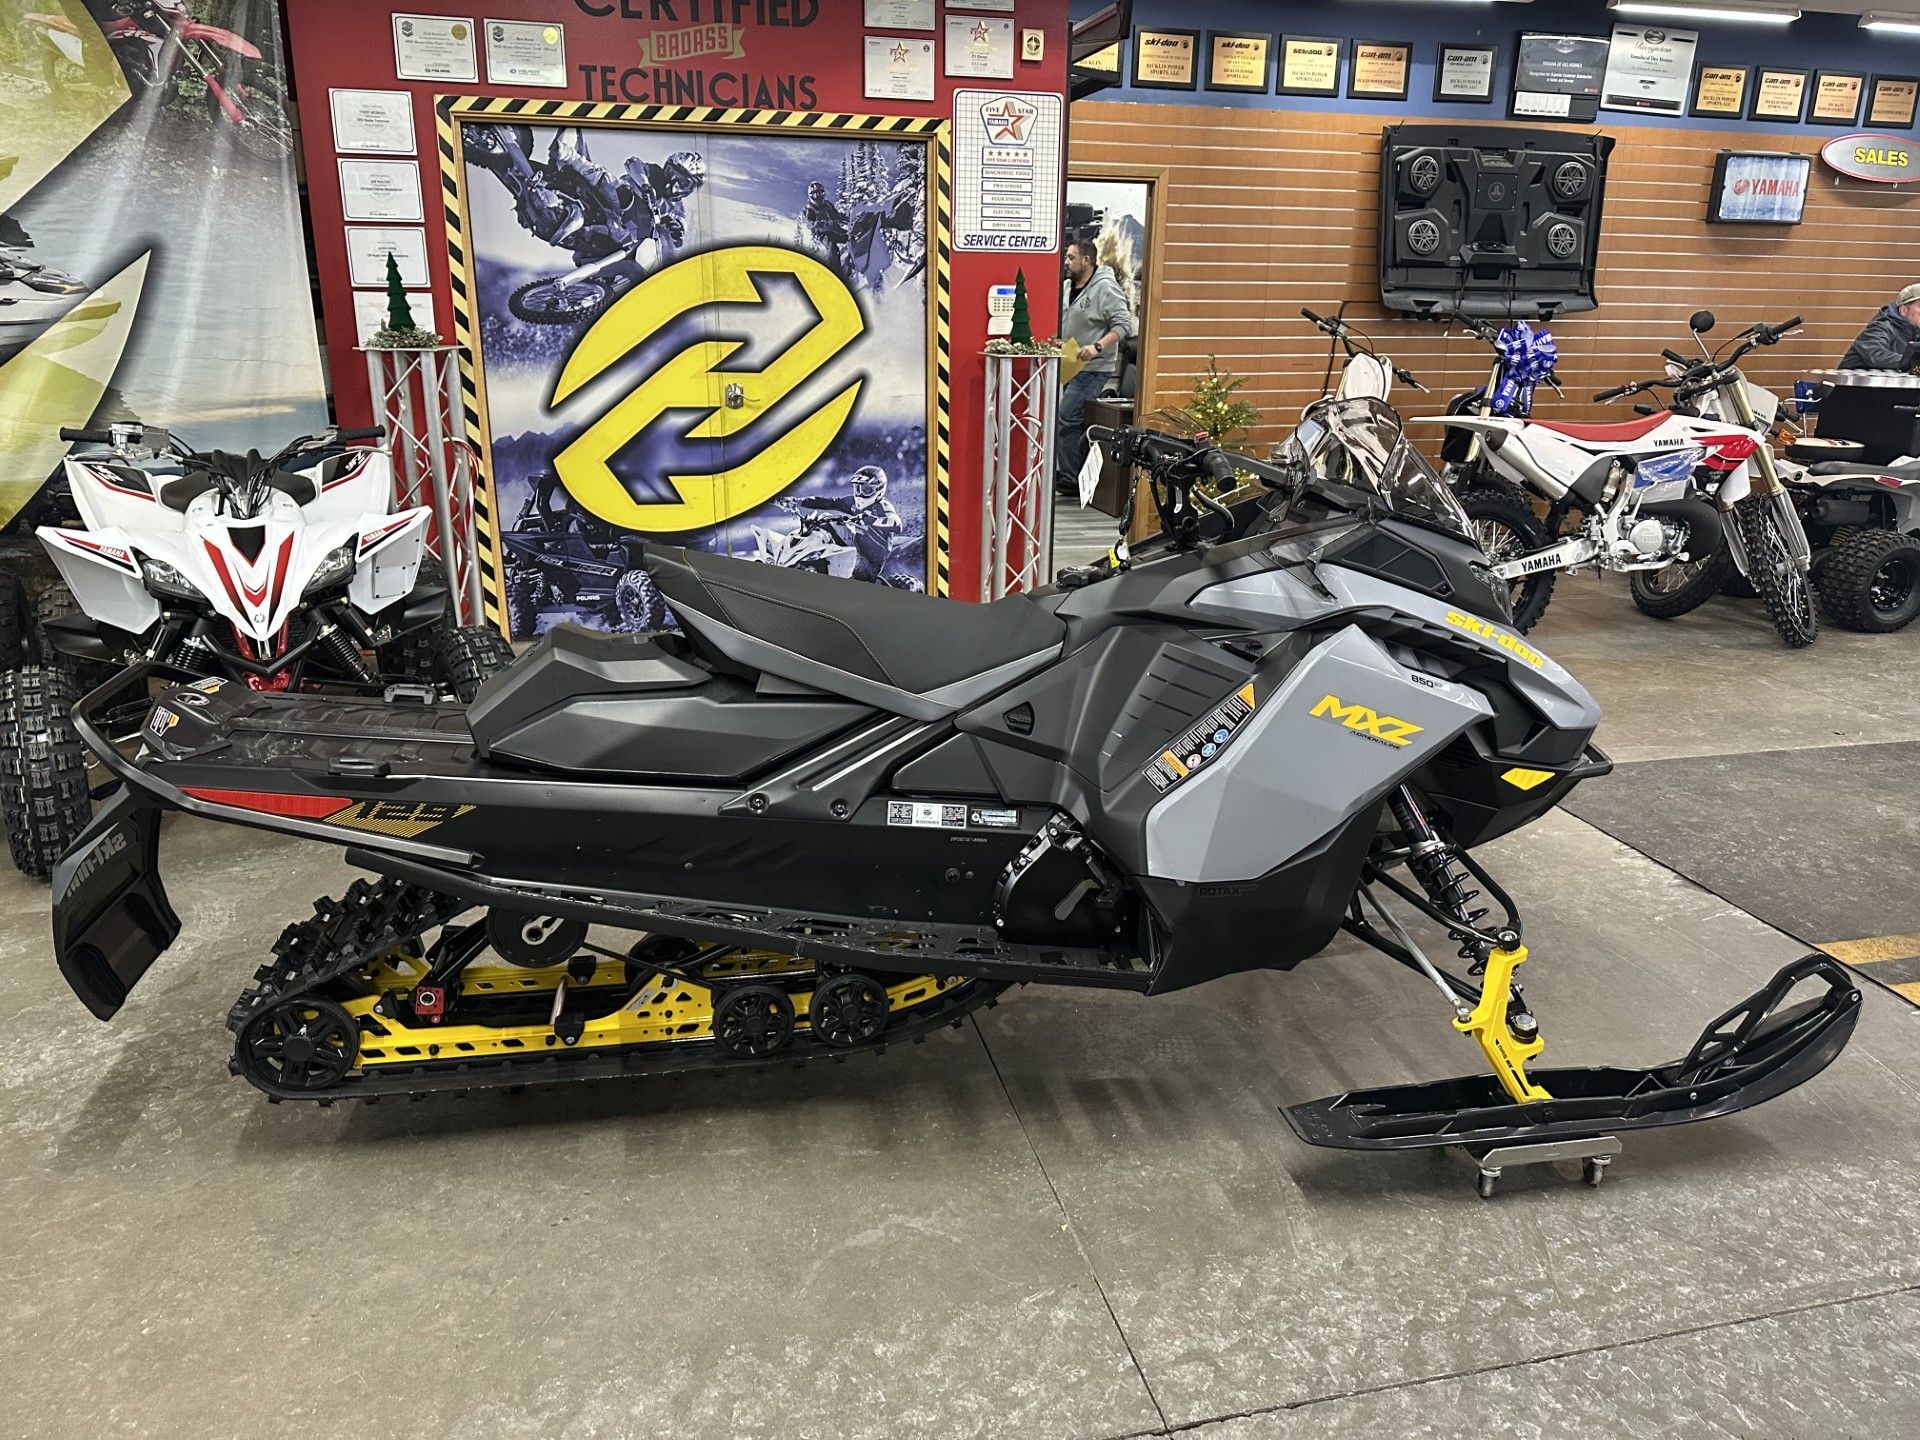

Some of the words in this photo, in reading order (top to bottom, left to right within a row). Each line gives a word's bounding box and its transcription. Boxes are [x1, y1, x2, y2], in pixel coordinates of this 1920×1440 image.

[656, 26, 728, 58] BADASS
[1144, 38, 1179, 47] ski-doo
[579, 65, 818, 110] TECHNICIANS
[1854, 147, 1909, 167] SALES
[1752, 179, 1799, 196] YAMAHA
[964, 234, 1006, 247] SERVICE
[1008, 236, 1048, 248] CENTER
[1654, 439, 1685, 447] YAMAHA
[364, 528, 384, 542] YAMAHA
[100, 546, 125, 558] YAMAHA
[1521, 554, 1562, 572] YAMAHA
[1444, 610, 1545, 670] ski-doo
[1412, 675, 1433, 688] 850
[1308, 694, 1424, 746] MXZ
[1350, 730, 1401, 750] ADRENALINE
[1200, 886, 1240, 896] ROTAX
